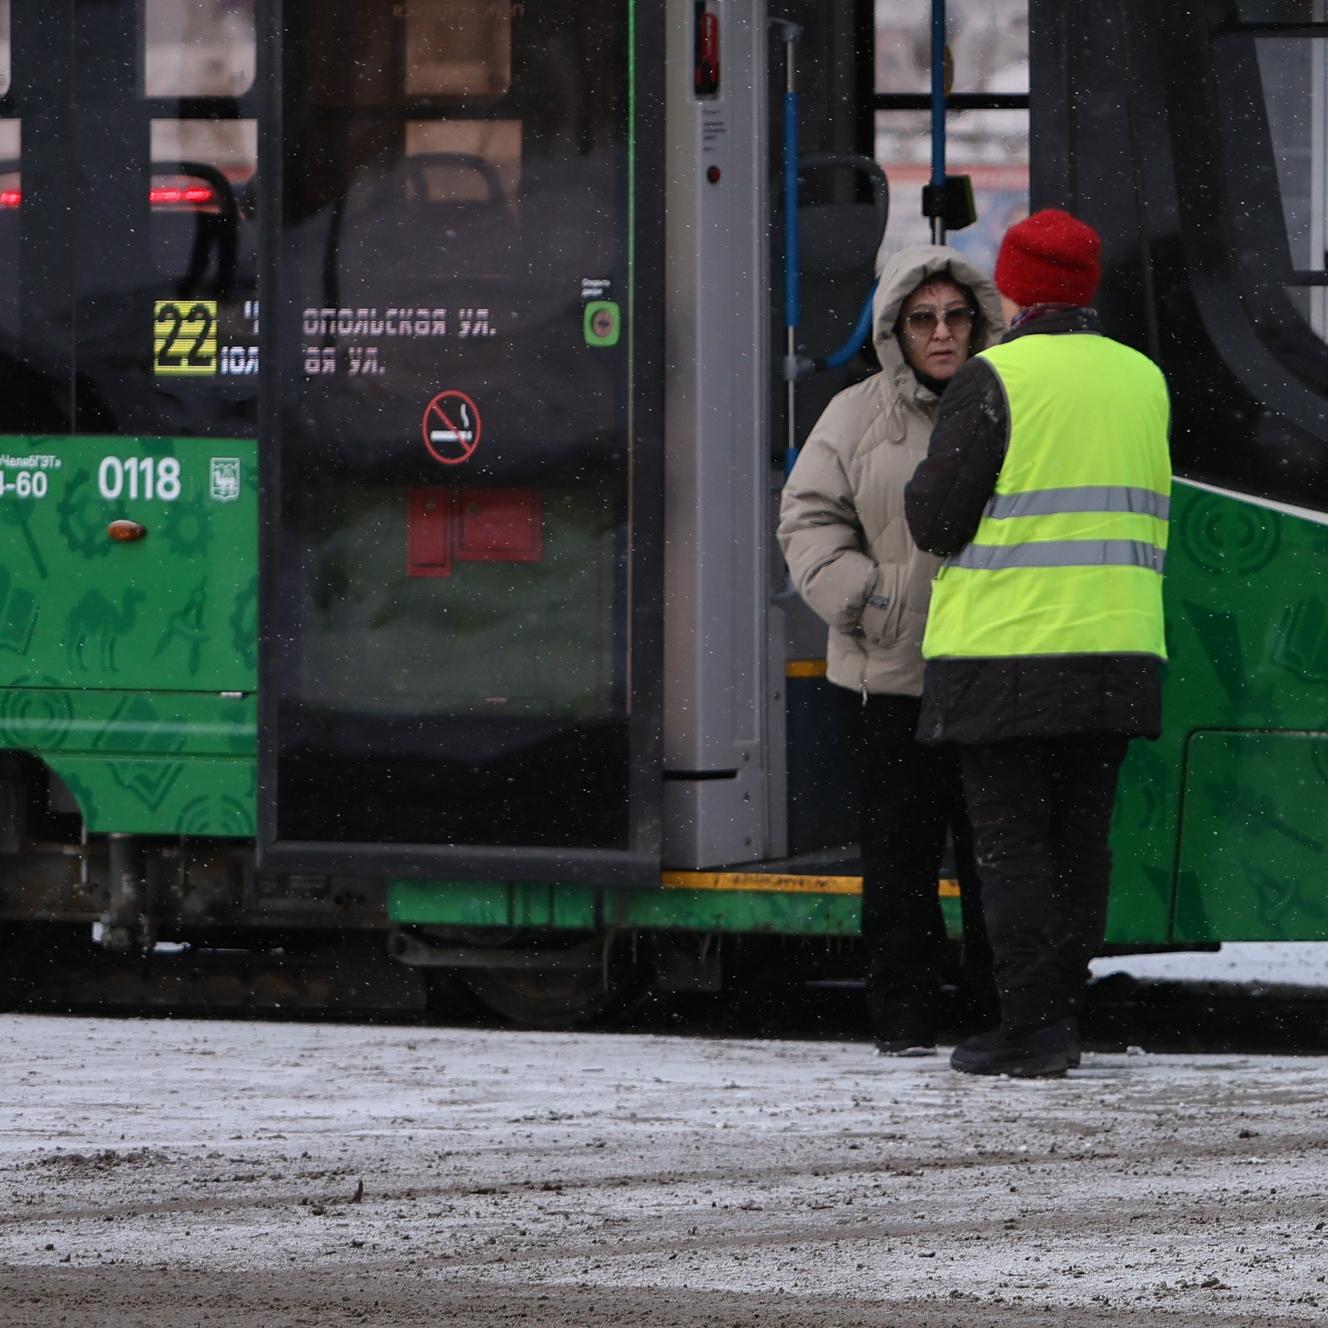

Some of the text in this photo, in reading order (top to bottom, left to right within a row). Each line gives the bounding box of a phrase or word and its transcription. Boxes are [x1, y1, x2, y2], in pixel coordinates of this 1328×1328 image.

[157, 303, 213, 367] 22
[0, 471, 48, 497] -60
[99, 456, 181, 499] 0118
